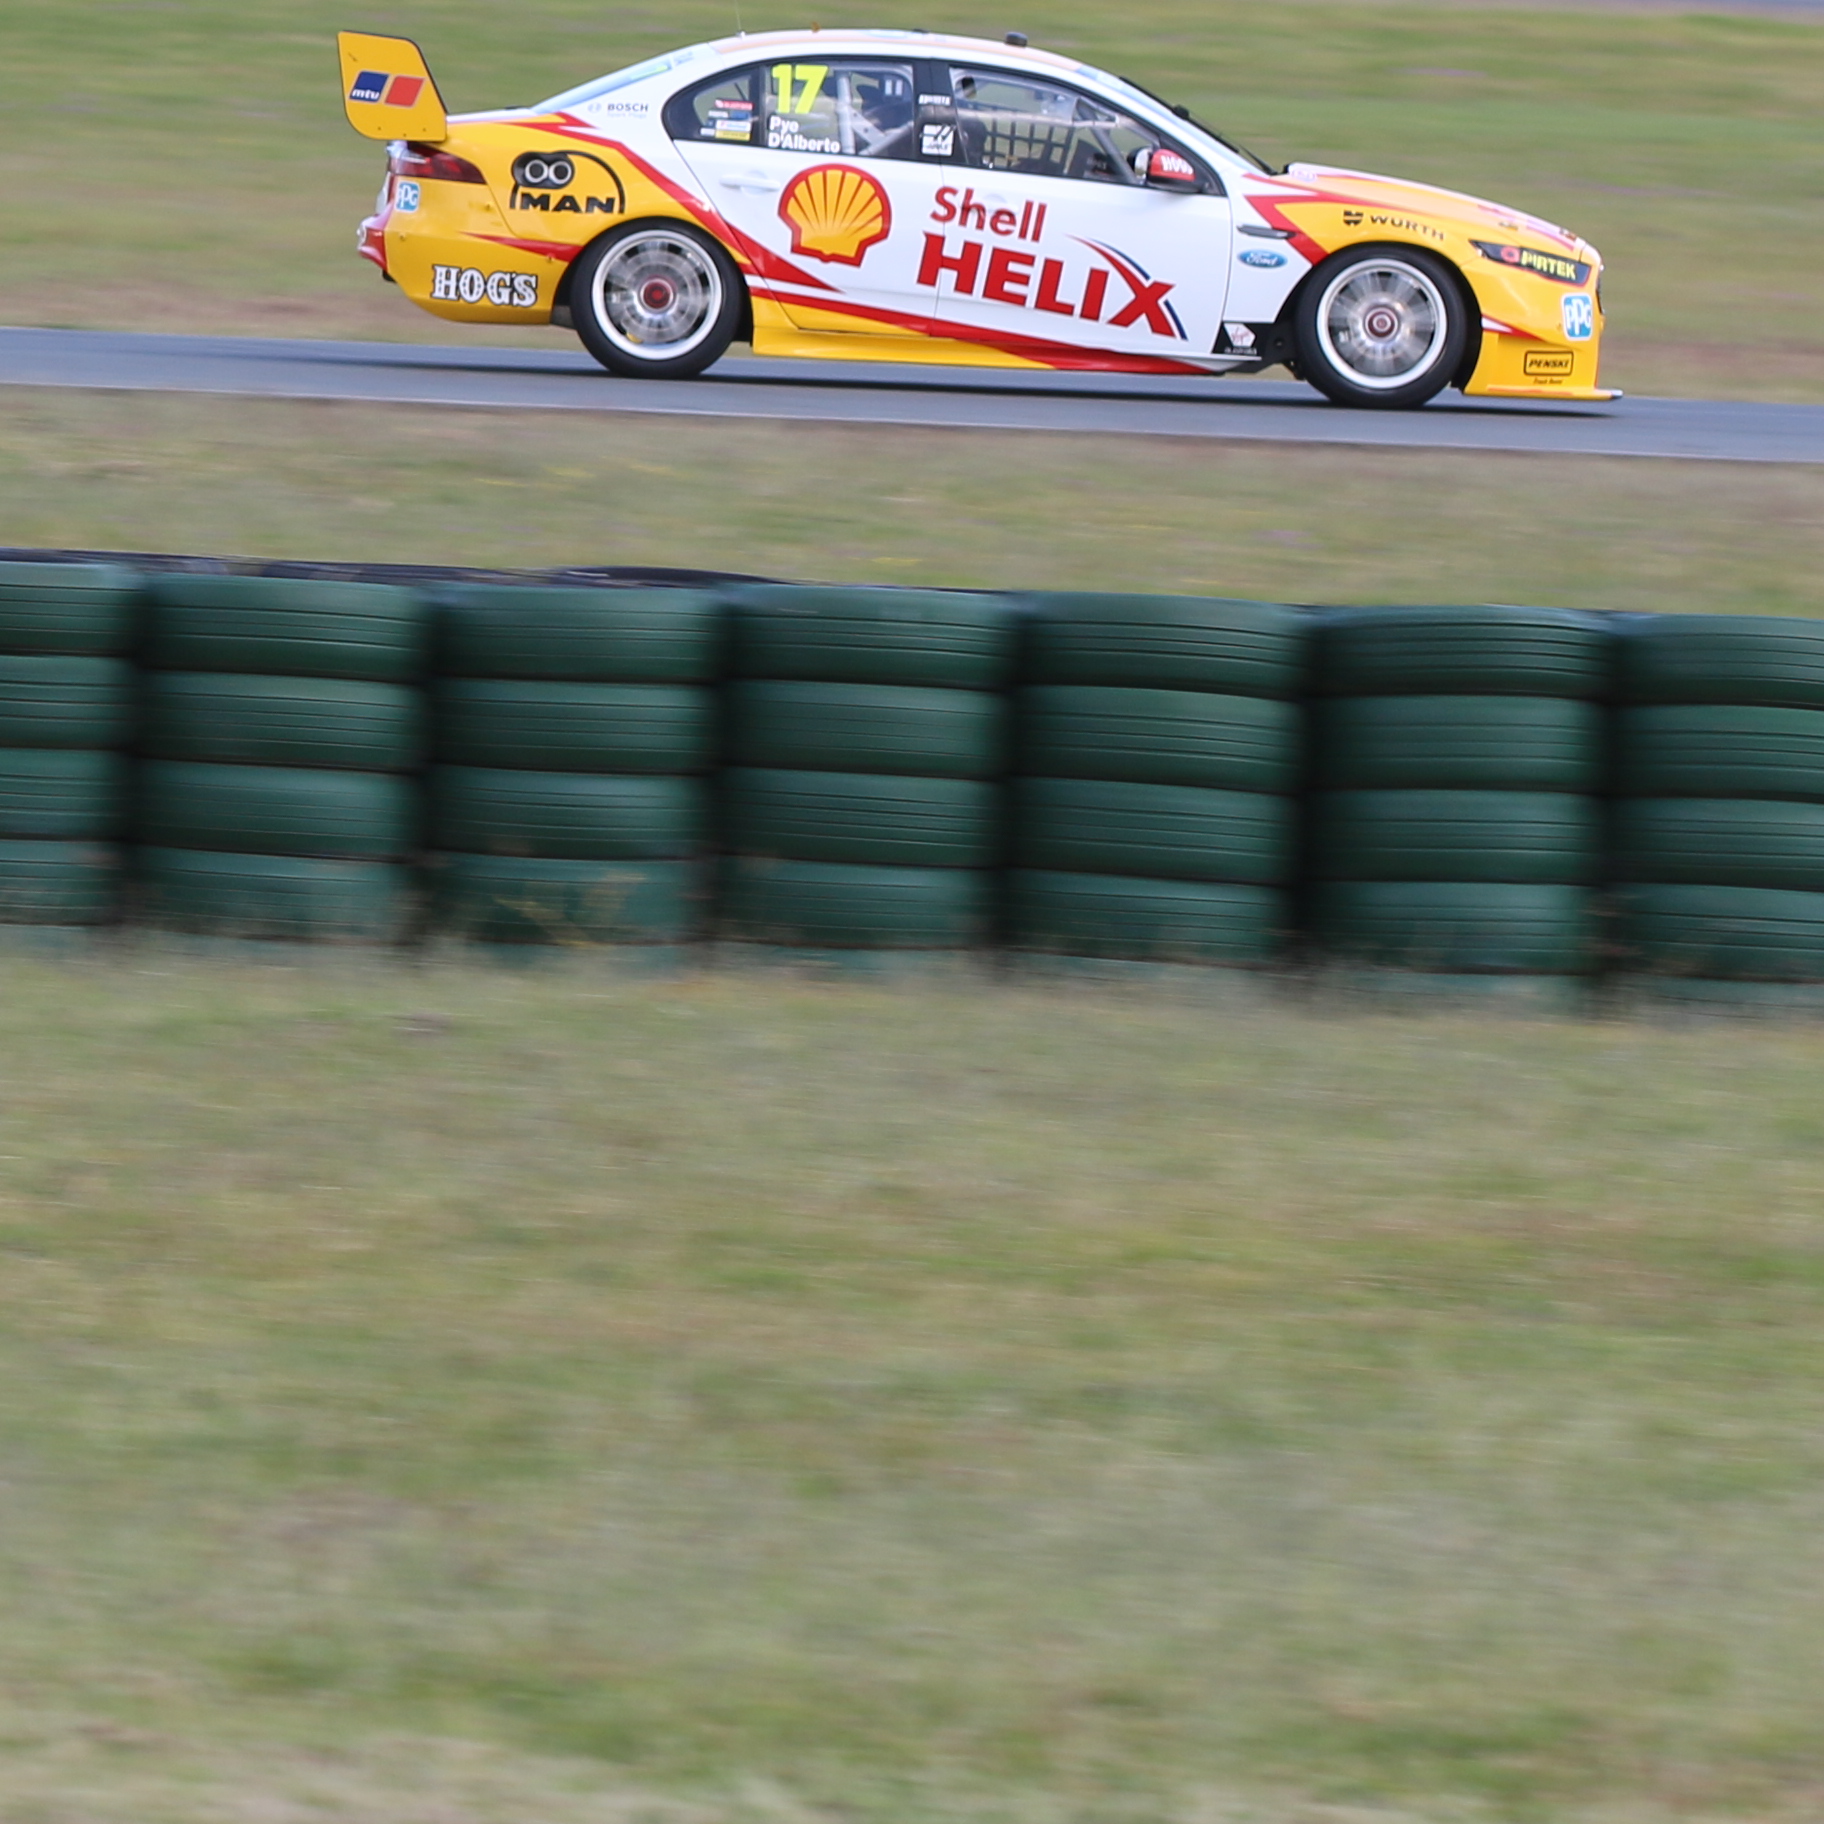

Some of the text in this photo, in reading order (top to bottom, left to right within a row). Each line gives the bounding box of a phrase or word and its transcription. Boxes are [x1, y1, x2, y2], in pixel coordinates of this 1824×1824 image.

[772, 64, 828, 114] 17
[607, 103, 648, 112] BOSCH
[770, 115, 799, 138] Pye
[768, 132, 841, 153] D'Alberto
[519, 192, 615, 214] MAN
[930, 186, 1047, 243] Shell
[1520, 250, 1577, 280] PIRTEK
[916, 230, 1180, 338] HELIX
[1565, 298, 1592, 336] PPG
